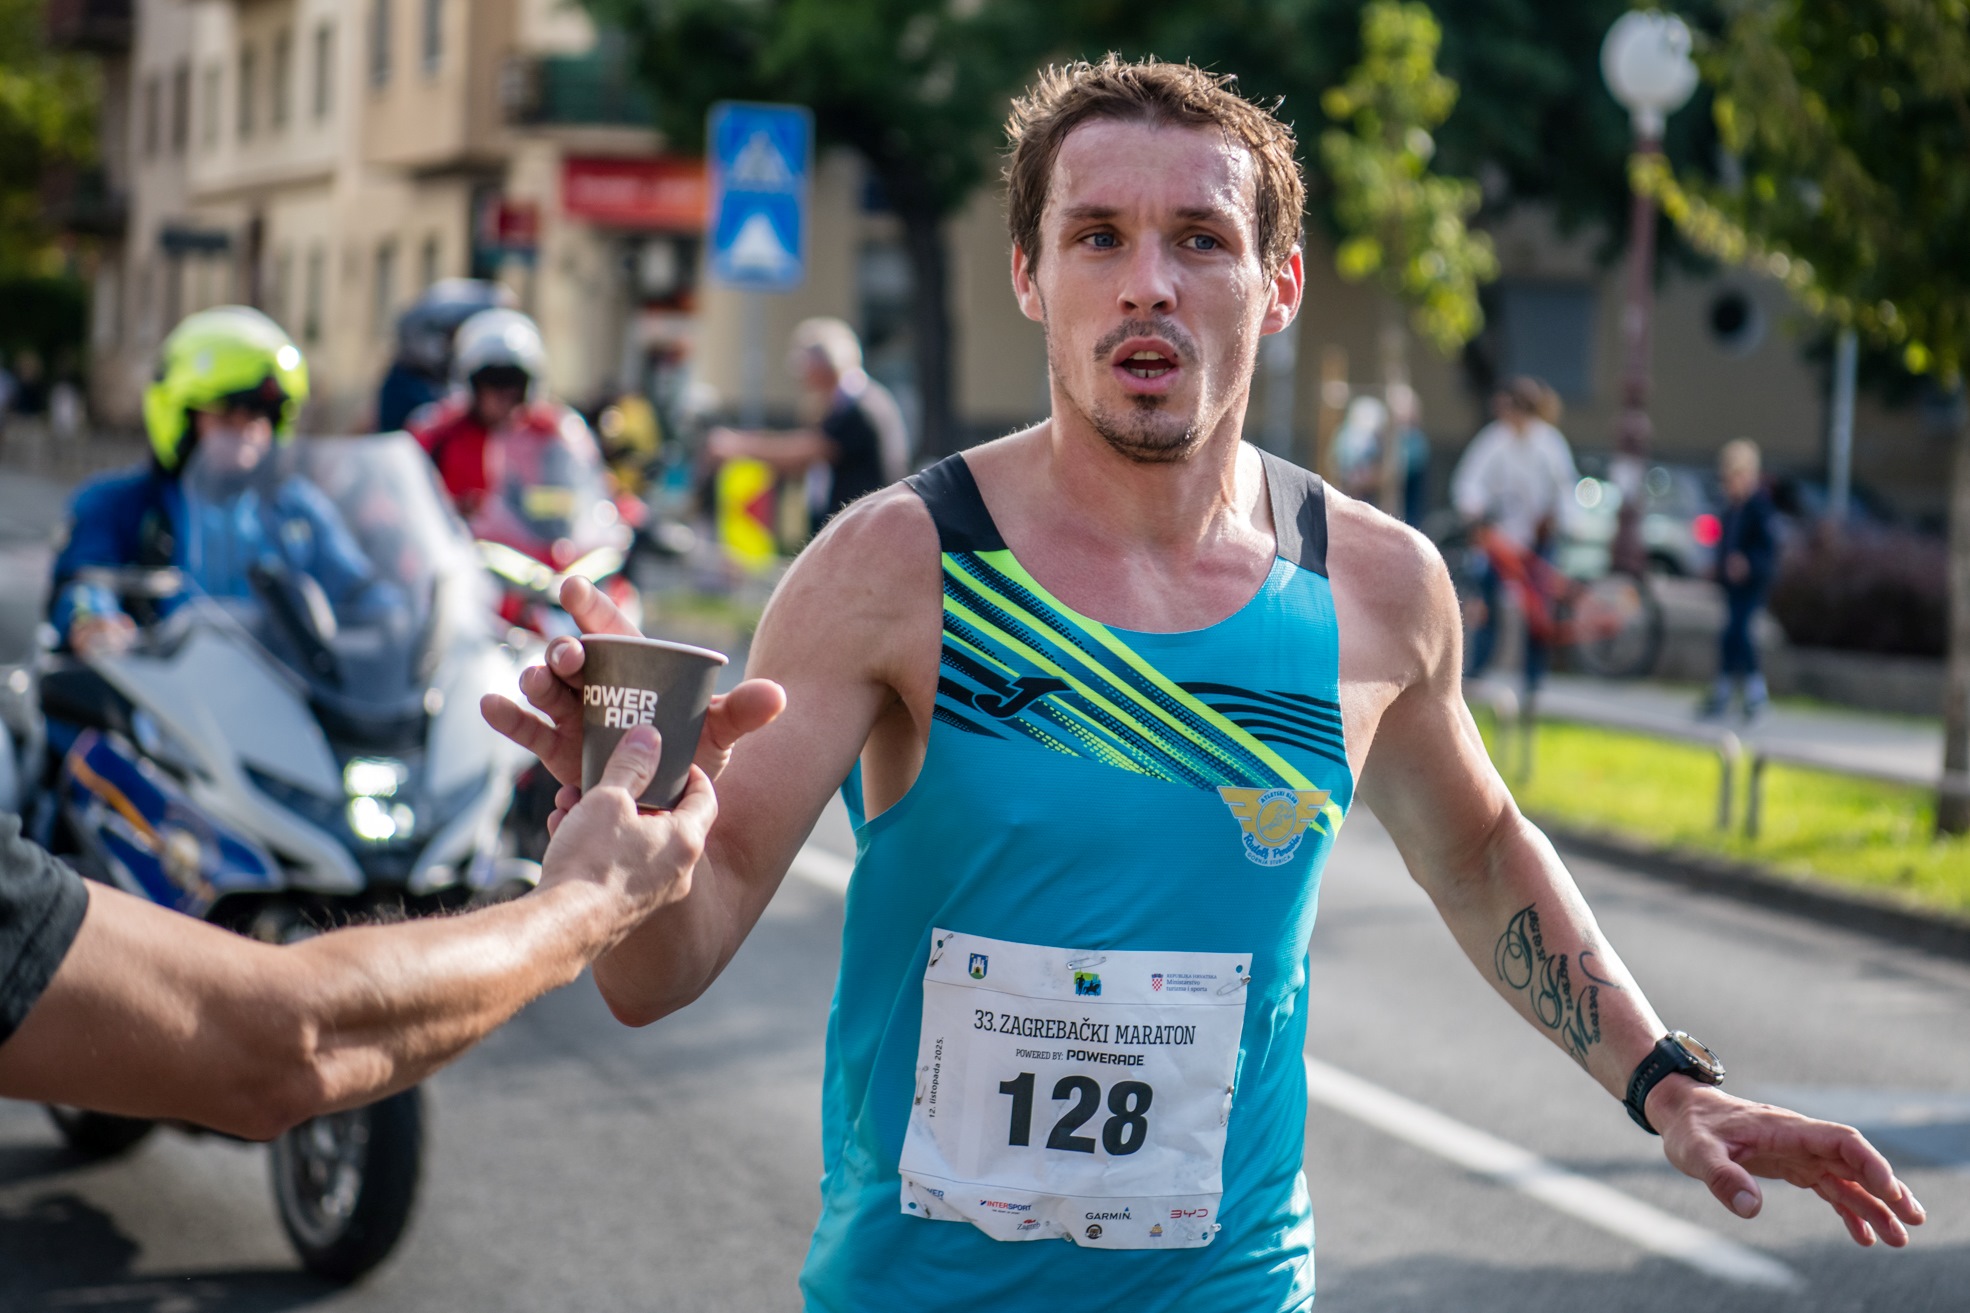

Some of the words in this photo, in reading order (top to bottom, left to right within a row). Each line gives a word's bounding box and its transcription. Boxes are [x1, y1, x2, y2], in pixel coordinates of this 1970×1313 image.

[583, 684, 658, 711] POWER
[1115, 1025, 1196, 1045] MARATON
[934, 1036, 944, 1061] 2025.
[1016, 1048, 1051, 1060] POWERED
[1052, 1050, 1064, 1060] BY:
[1066, 1049, 1145, 1066] POWERADE
[929, 1063, 941, 1105] listopada
[999, 1072, 1154, 1156] 128
[986, 1200, 1032, 1211] INTERSPORT
[1170, 1208, 1208, 1218] BYD
[1085, 1212, 1131, 1220] GARMIN
